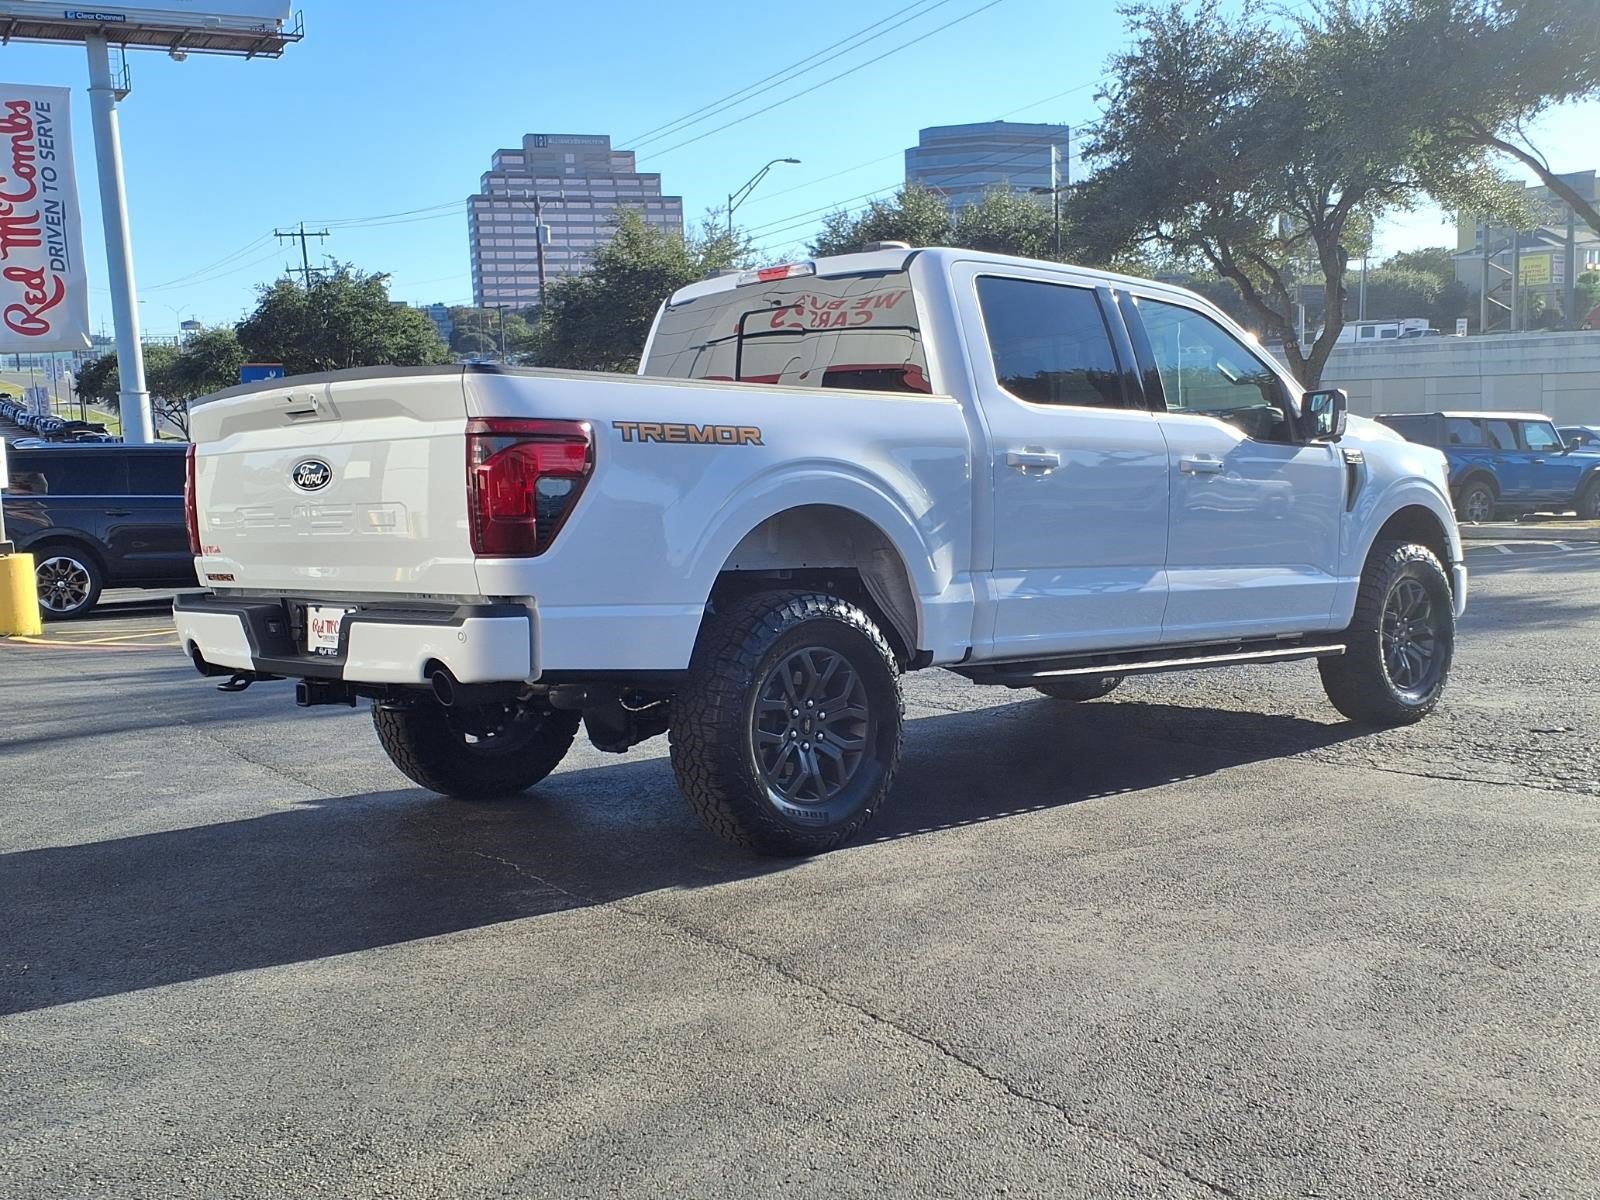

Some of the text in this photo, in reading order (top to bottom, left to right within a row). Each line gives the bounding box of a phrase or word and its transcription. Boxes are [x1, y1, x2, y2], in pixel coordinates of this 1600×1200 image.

[76, 12, 124, 22] Clear Channel
[34, 101, 65, 273] DRIVEN TO SERVE
[3, 266, 65, 336] Red
[612, 421, 765, 446] TREMOR
[298, 464, 323, 485] Ford
